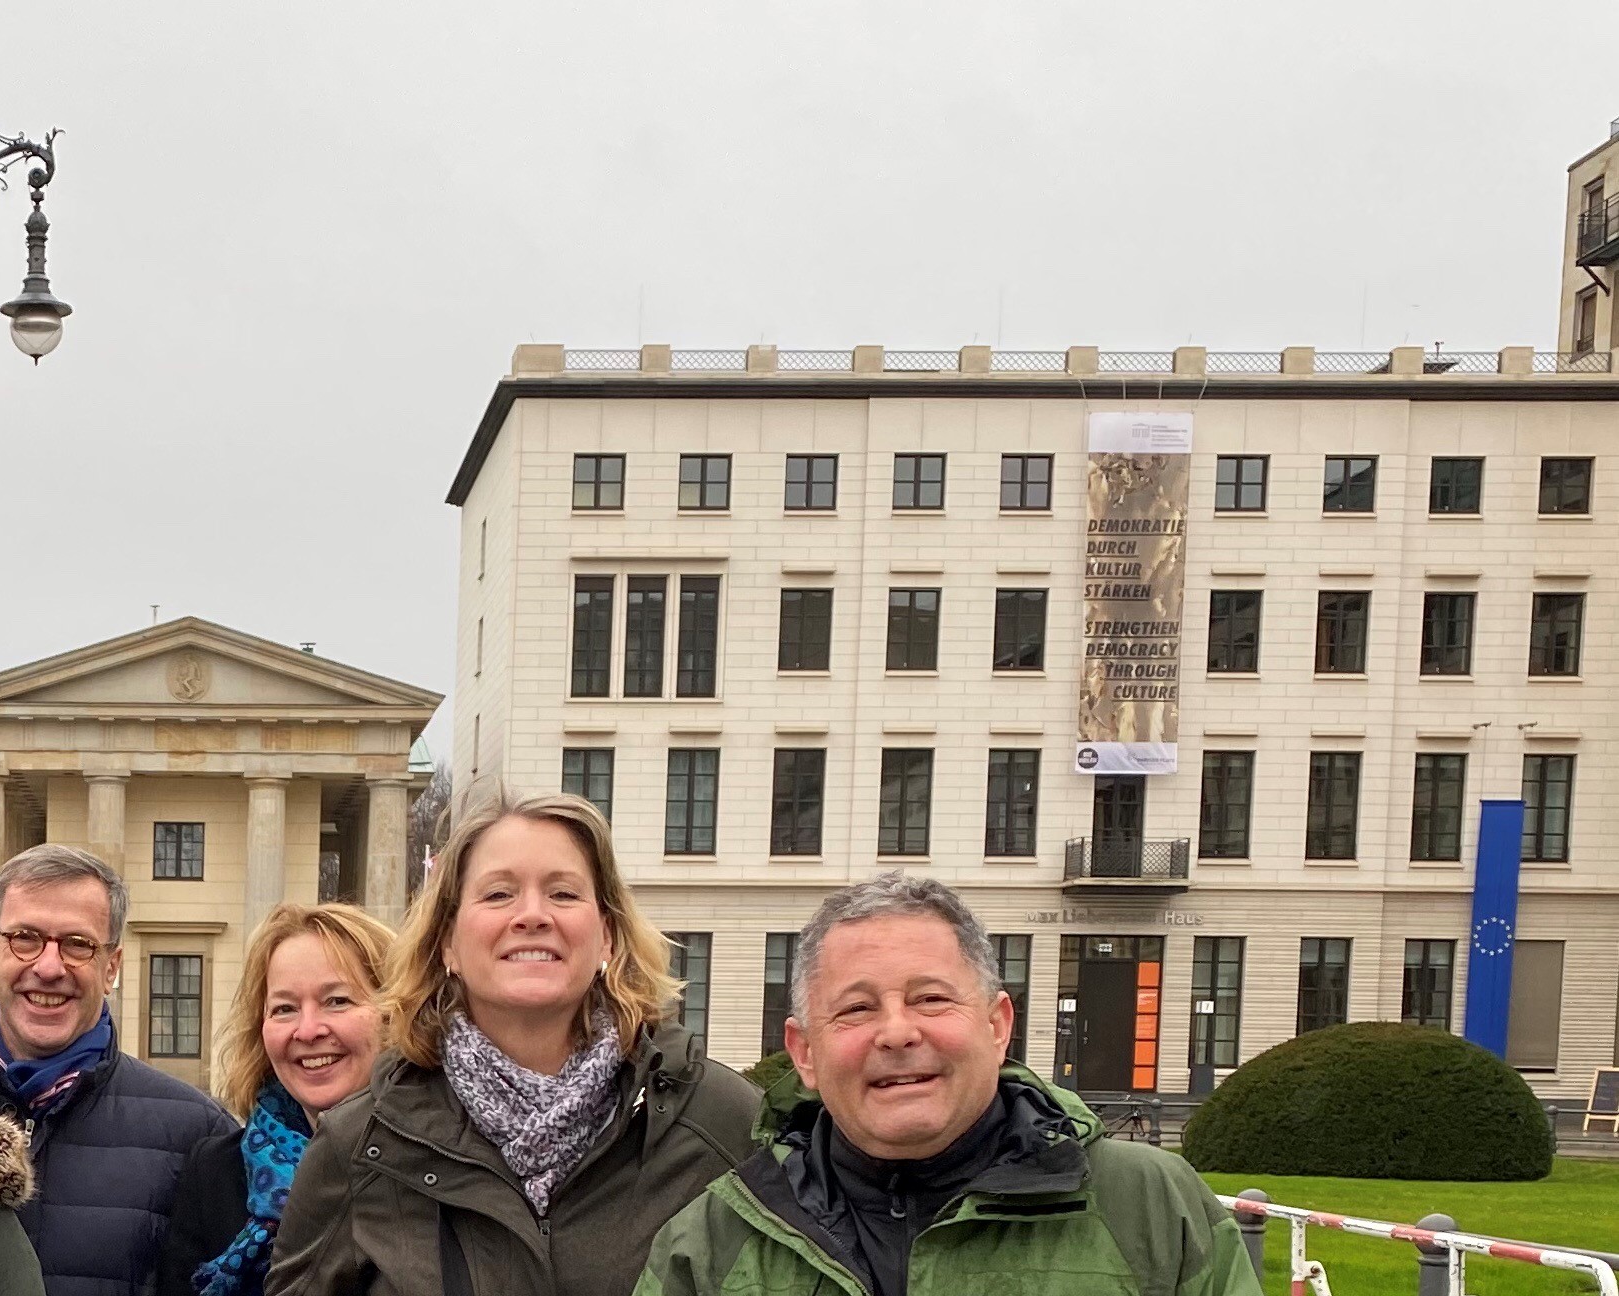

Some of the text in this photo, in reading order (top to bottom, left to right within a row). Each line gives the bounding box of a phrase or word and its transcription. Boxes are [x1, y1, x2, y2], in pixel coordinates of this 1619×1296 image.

[1087, 519, 1184, 532] DEMOKRATIE
[1087, 541, 1137, 554] DURCH
[1085, 562, 1142, 576] KULTUR
[1084, 581, 1152, 597] STÄRKEN
[1085, 621, 1179, 635] STRENGTHEN
[1085, 642, 1178, 656] DEMOCRACY
[1105, 662, 1178, 677] THROUGH
[1113, 685, 1178, 699] CULTURE
[1164, 910, 1204, 925] Haus
